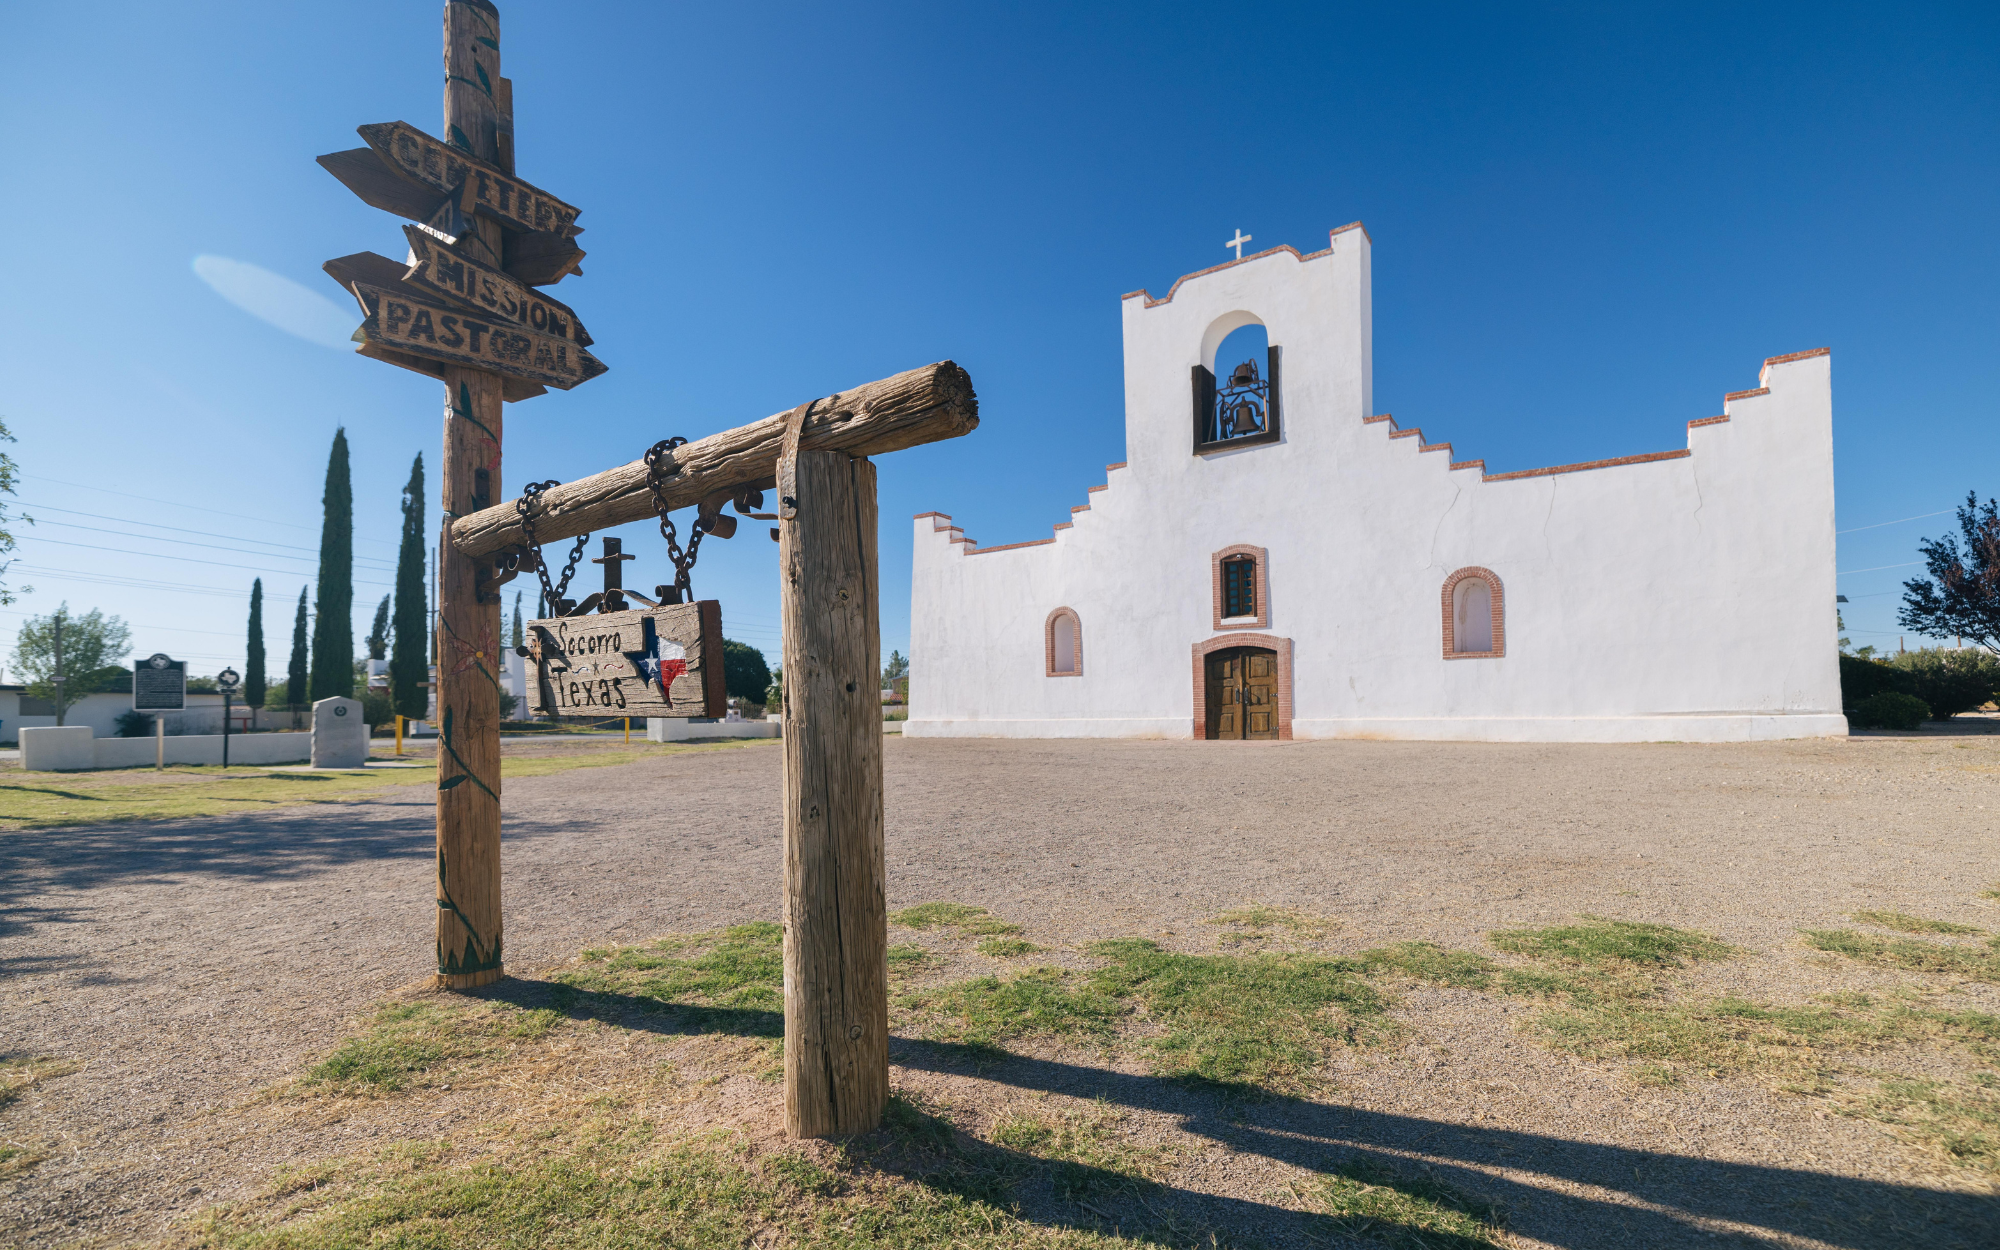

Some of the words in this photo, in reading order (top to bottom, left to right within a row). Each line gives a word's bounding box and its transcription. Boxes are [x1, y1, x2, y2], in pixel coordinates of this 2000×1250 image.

[397, 131, 575, 235] CEMETERY
[437, 250, 568, 338] MISSION
[386, 300, 577, 376] PASTORAL
[559, 621, 621, 656] Socorro
[551, 667, 627, 709] Texas
